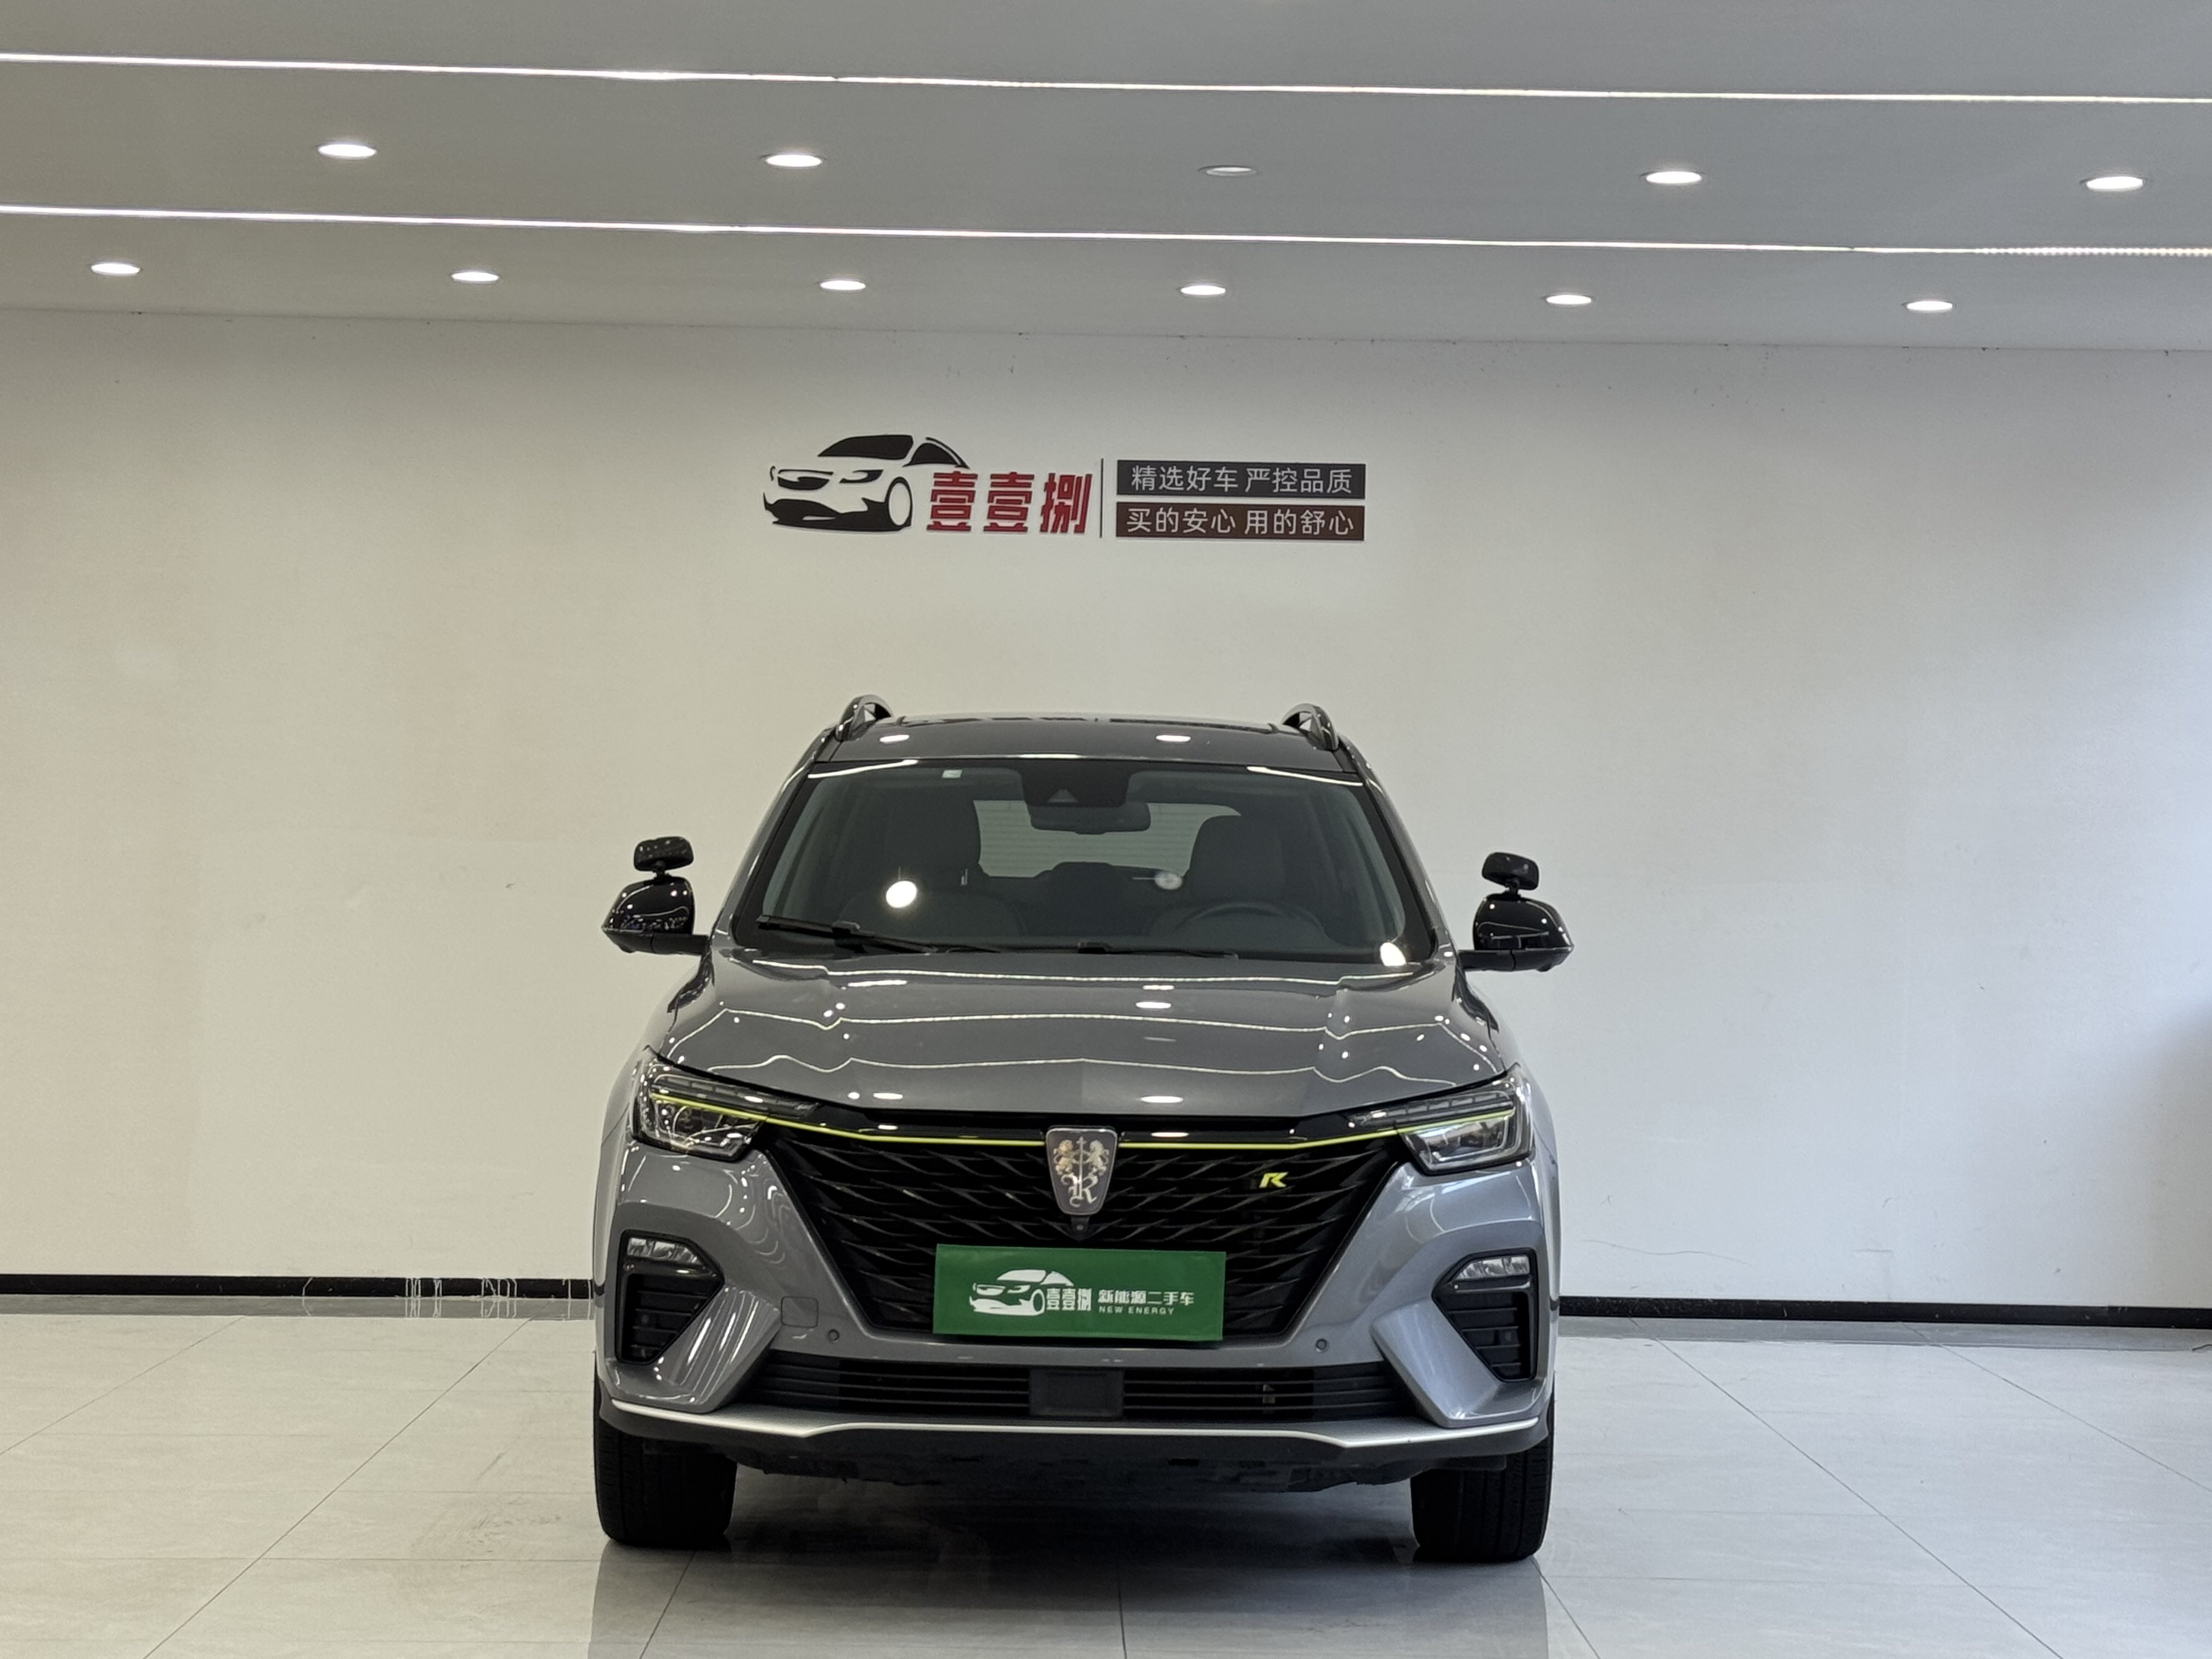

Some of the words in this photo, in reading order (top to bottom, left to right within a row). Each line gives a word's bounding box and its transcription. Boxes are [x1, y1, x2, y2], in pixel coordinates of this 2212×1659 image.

[1131, 465, 1239, 493] 精选好车
[1244, 467, 1353, 494] 严控品质
[926, 471, 1093, 534] 壹壹捌
[1126, 507, 1236, 534] 买的安心
[1244, 509, 1354, 536] 用的舒心
[1098, 1289, 1194, 1306] 新能源二手车
[1099, 1306, 1124, 1314] NEW
[1128, 1307, 1174, 1315] ENERGY
